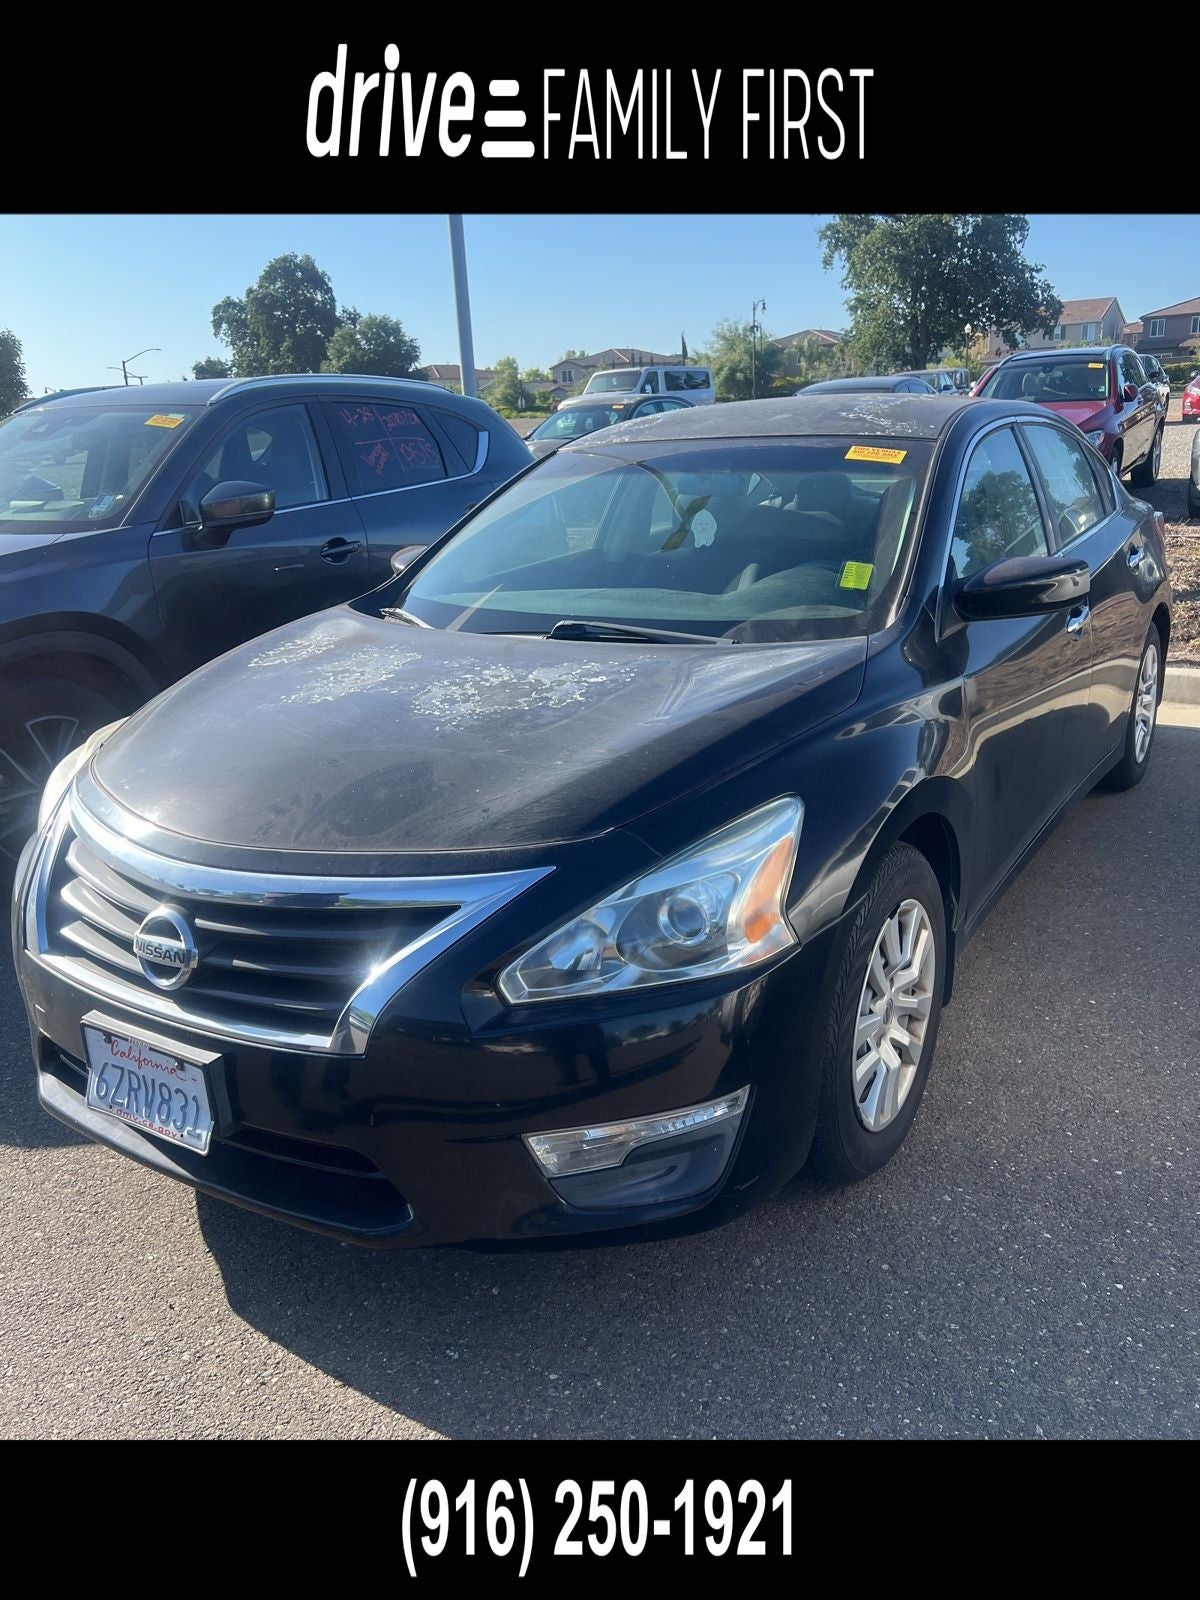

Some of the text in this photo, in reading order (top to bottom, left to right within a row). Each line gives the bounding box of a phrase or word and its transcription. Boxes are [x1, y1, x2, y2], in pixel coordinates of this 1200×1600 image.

[135, 939, 186, 964] NISSAN
[110, 1039, 188, 1082] California
[95, 1061, 203, 1140] 6ZRV831
[116, 1108, 178, 1139] dmv.ca.gov
